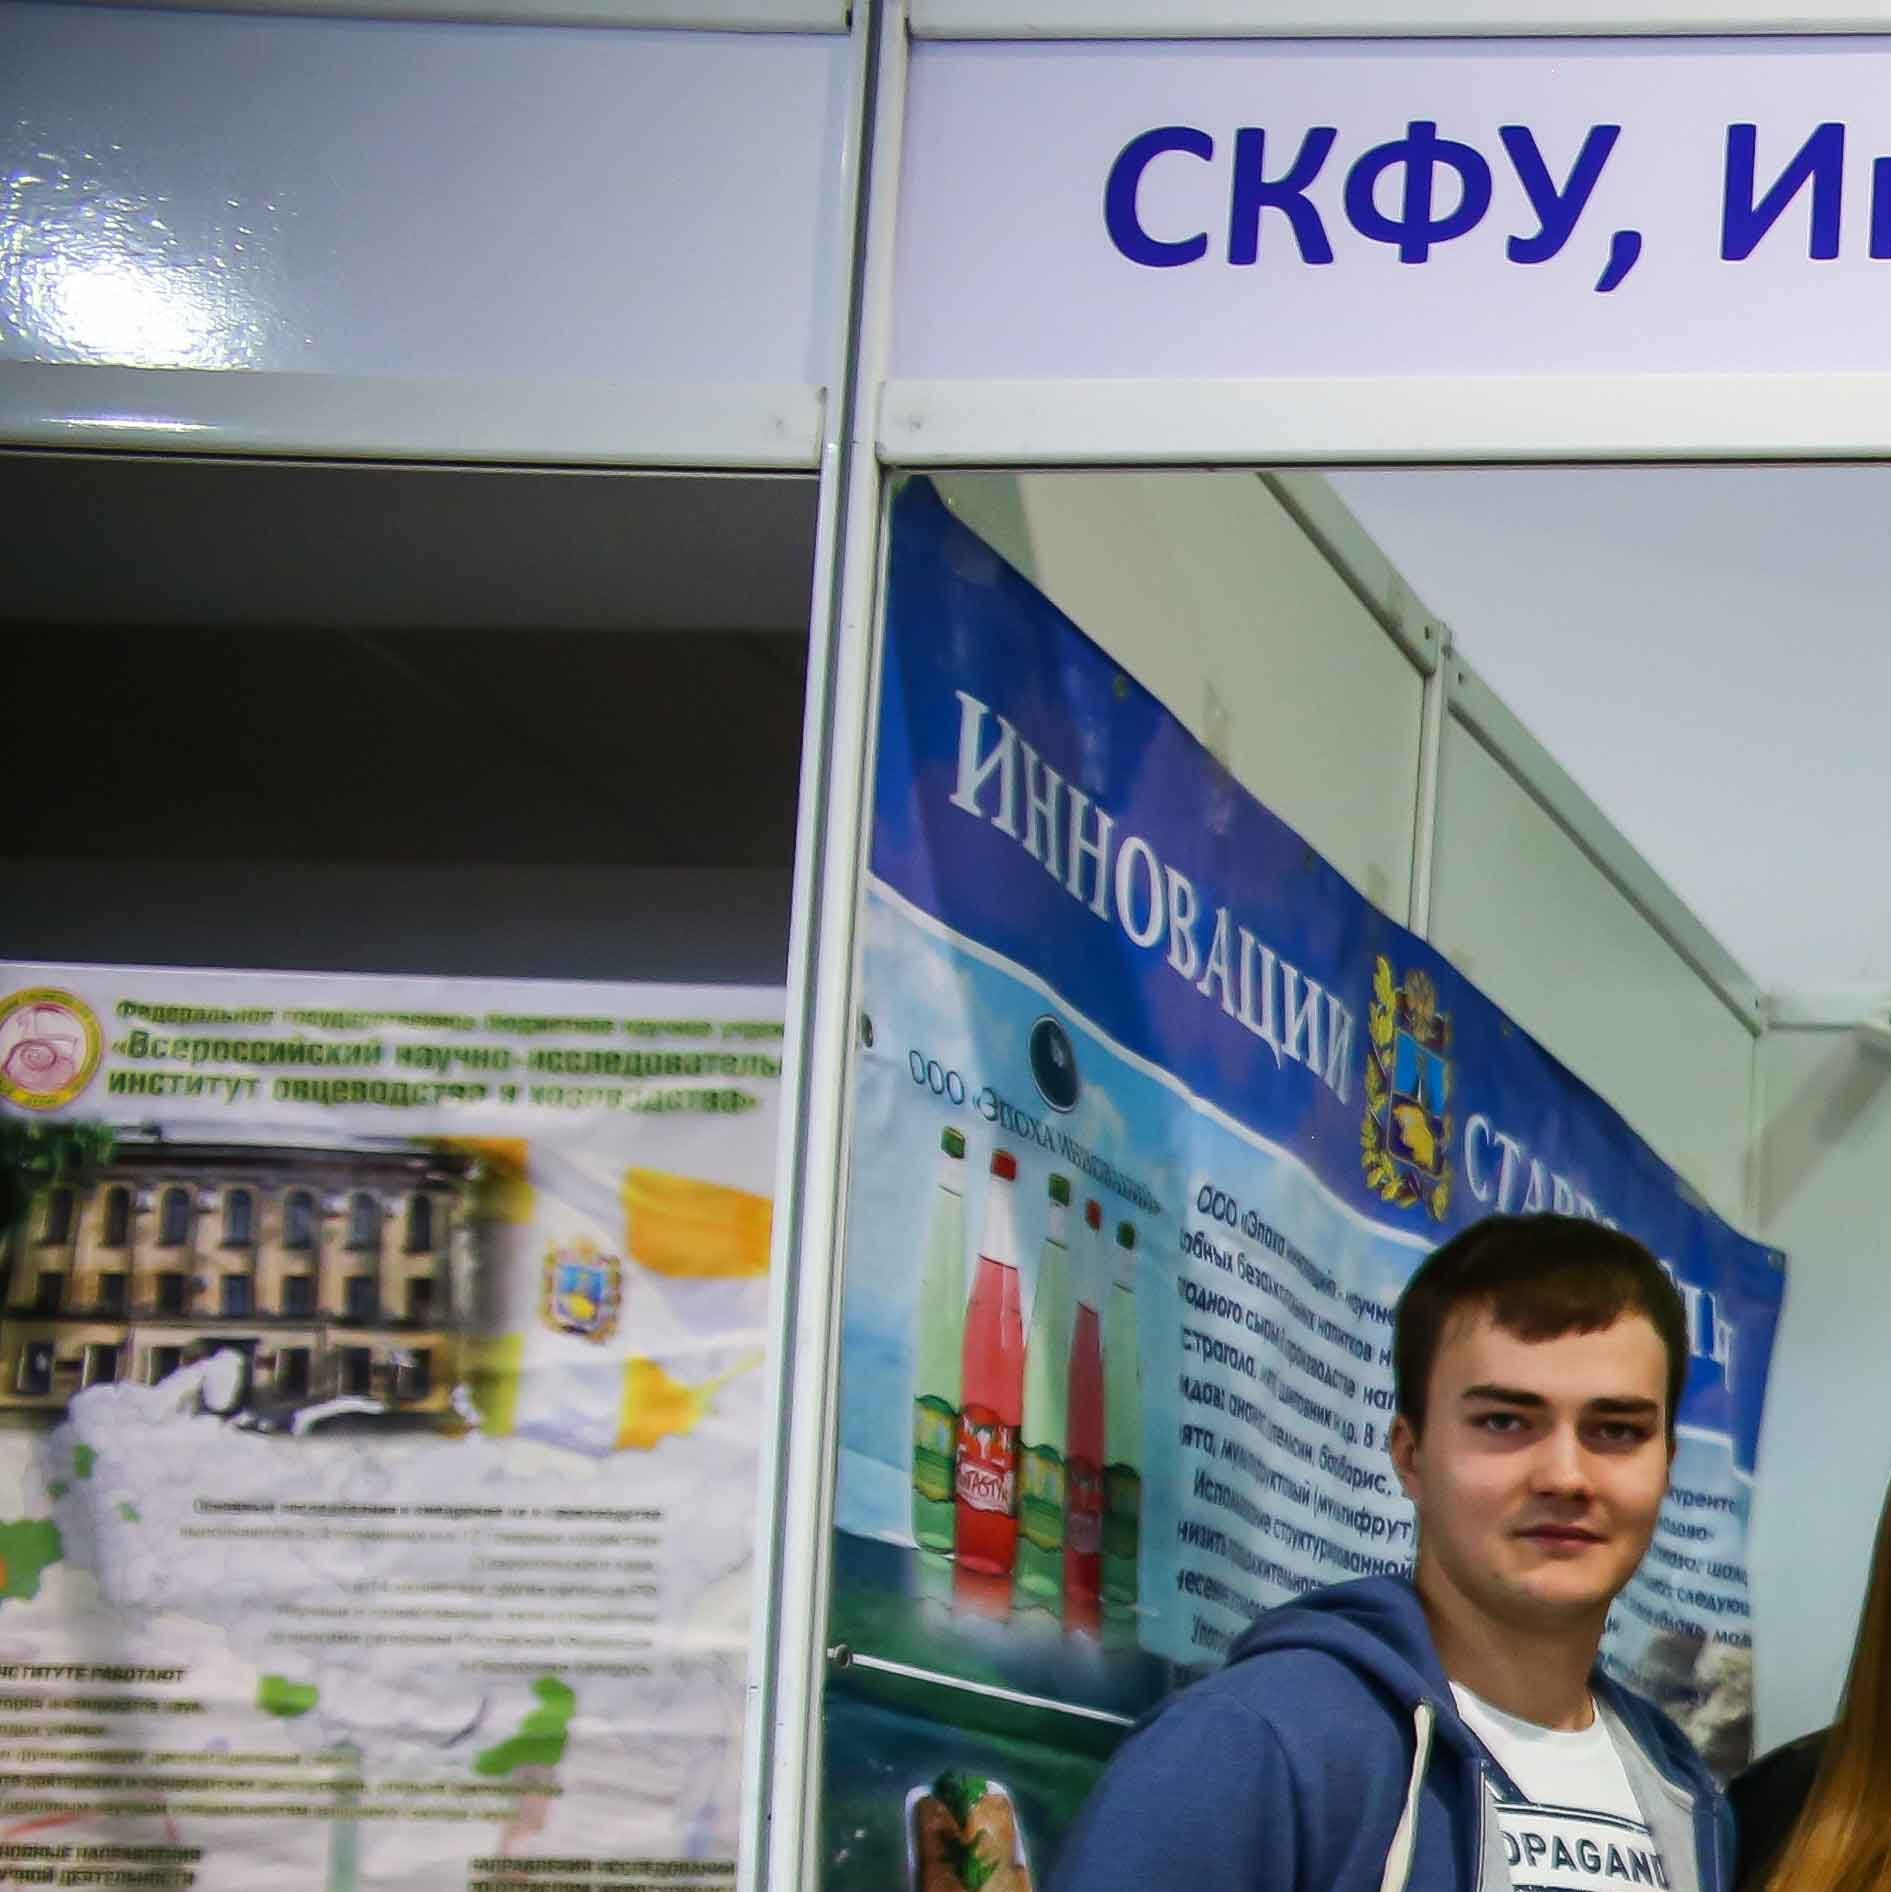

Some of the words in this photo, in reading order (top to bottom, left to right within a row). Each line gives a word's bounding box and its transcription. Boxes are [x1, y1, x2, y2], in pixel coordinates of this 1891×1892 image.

[1100, 122, 1645, 292] СКФУ,
[949, 690, 1354, 1104] ИННОВАЦИИ
[395, 1044, 780, 1077] научно-исследователь
